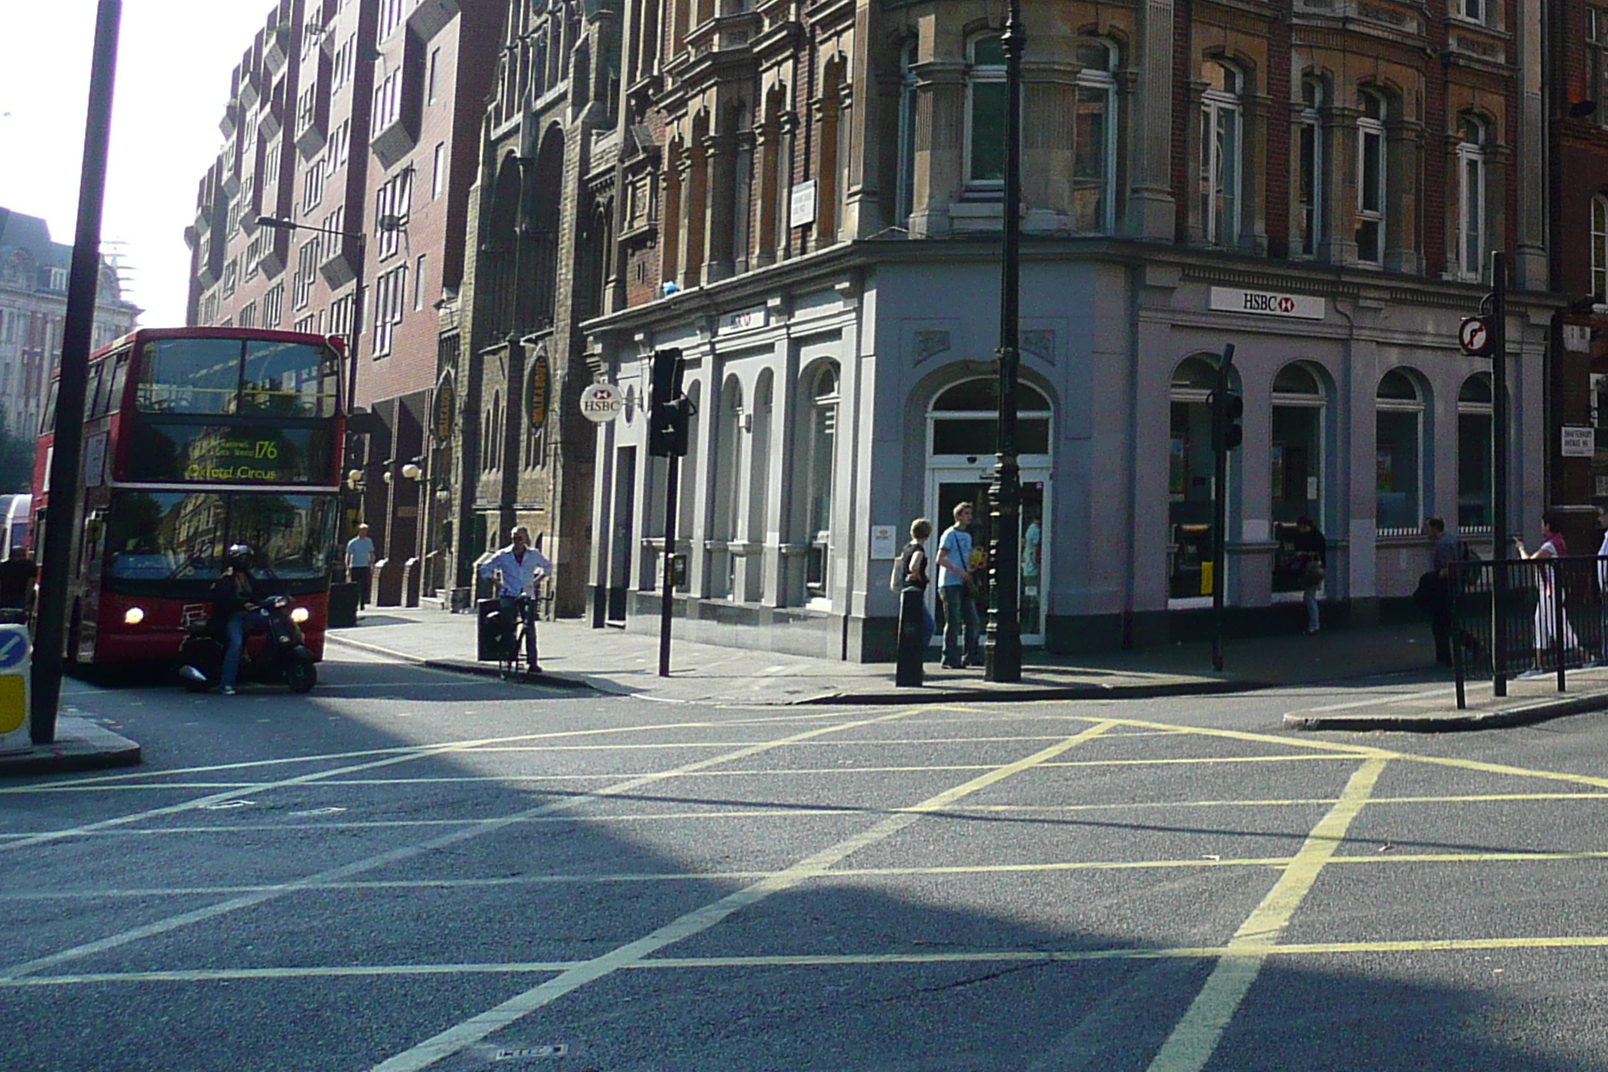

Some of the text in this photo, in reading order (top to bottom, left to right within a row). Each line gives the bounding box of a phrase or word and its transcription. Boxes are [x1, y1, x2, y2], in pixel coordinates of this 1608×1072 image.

[1243, 293, 1277, 312] HSBC
[584, 400, 620, 412] HSBC
[255, 441, 278, 459] 176
[187, 464, 234, 479] Oxford
[237, 466, 277, 480] Circus
